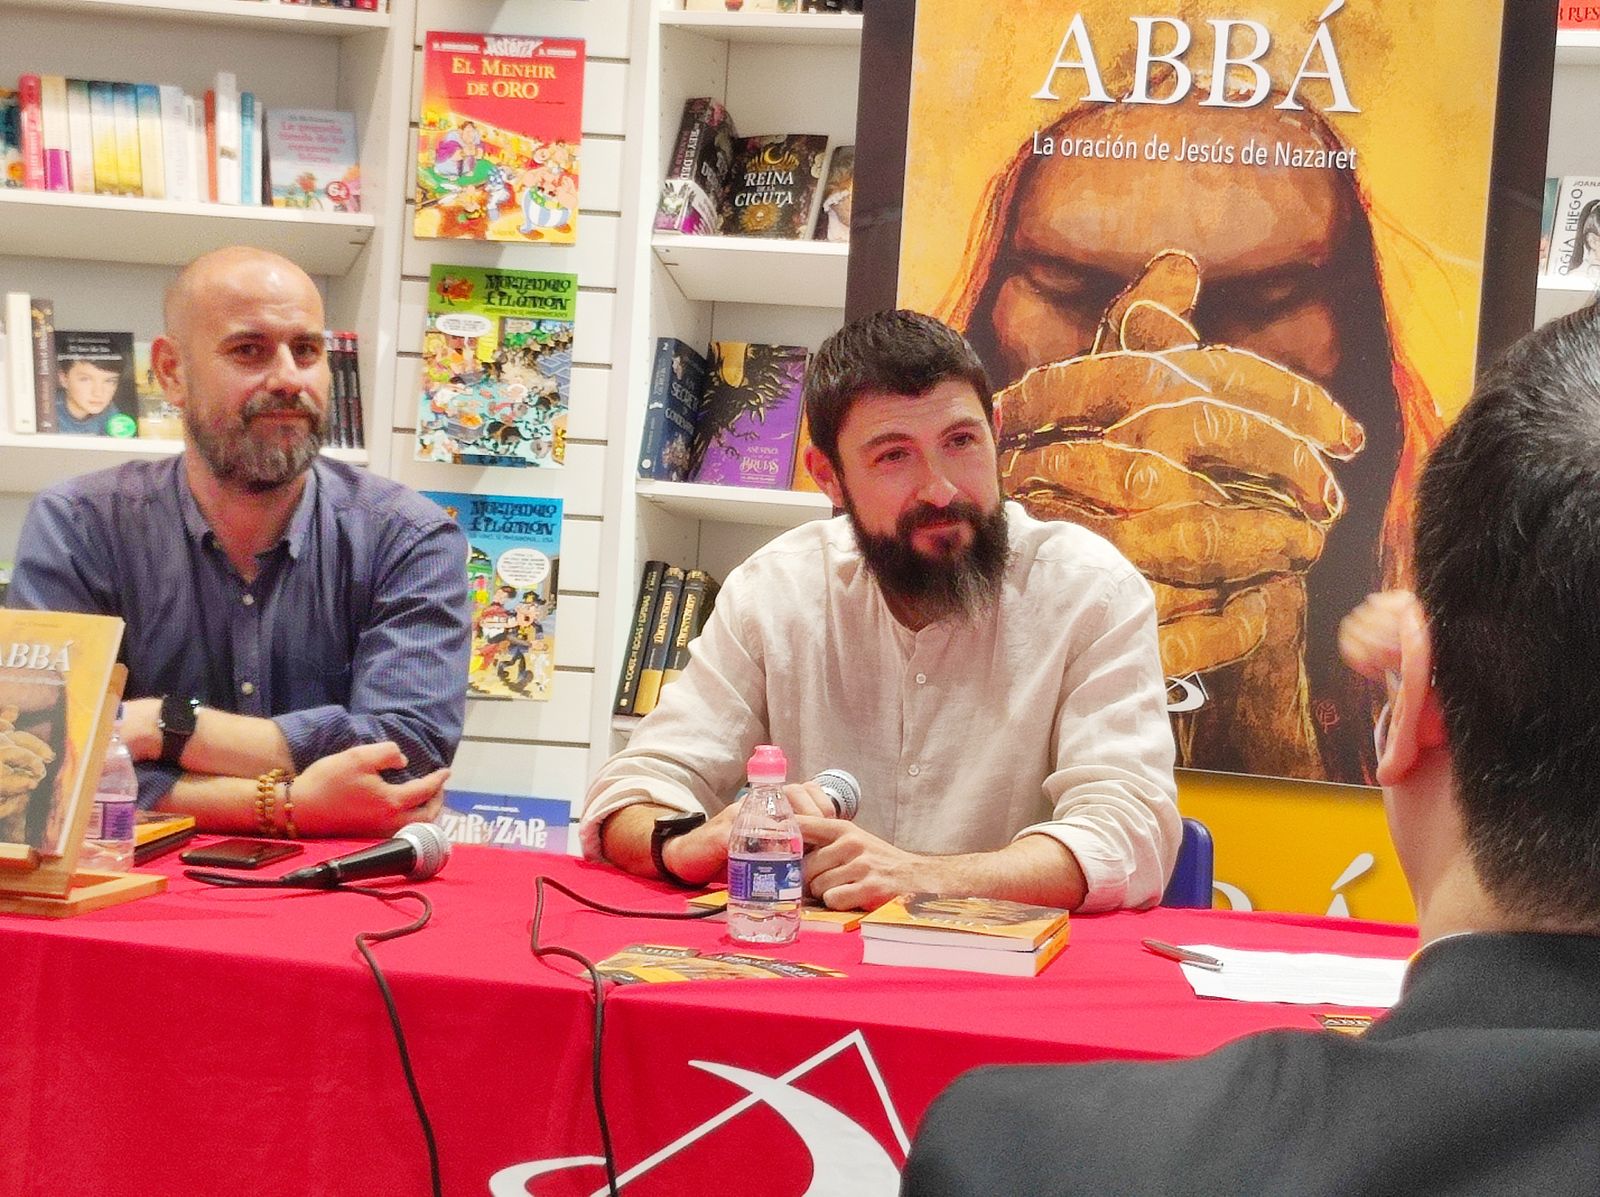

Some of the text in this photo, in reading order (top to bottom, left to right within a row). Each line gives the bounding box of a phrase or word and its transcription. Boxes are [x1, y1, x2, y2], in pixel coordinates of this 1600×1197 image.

[452, 56, 556, 79] EL MENHIR
[1031, 0, 1362, 113] ABBÁ
[466, 80, 539, 99] DE ORO
[1032, 130, 1357, 170] La oración de Jesús de Nazaret
[743, 171, 794, 187] REINA
[734, 191, 793, 208] CICUTA
[1565, 188, 1583, 232] FUEGO
[0, 640, 74, 672] BBÁ
